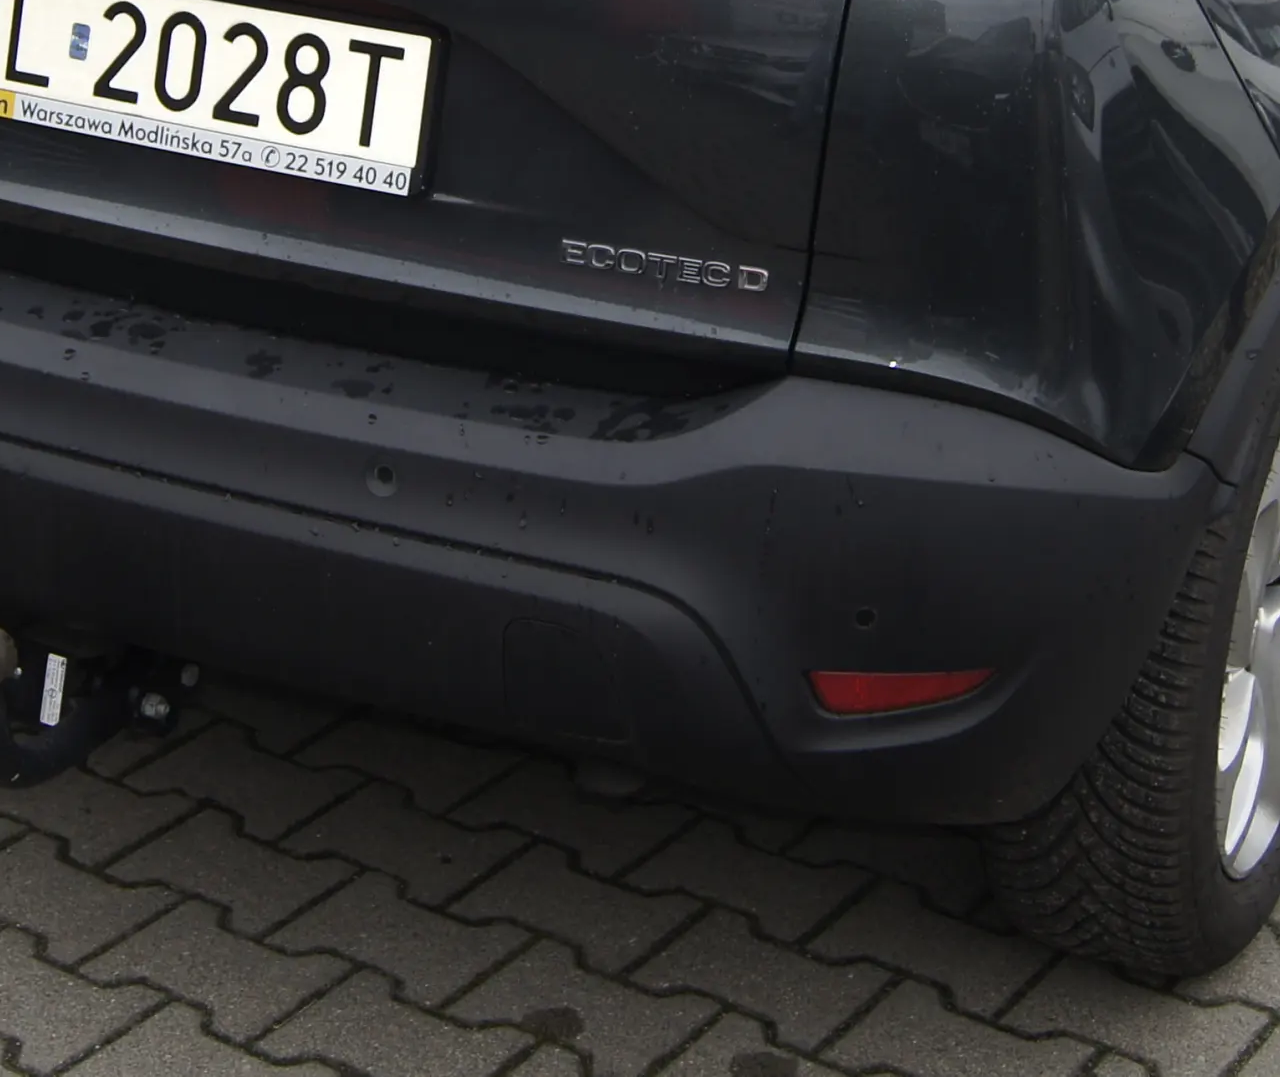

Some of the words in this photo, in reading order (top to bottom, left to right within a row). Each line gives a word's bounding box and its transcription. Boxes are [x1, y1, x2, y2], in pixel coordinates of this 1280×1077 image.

[93, 1, 405, 147] 2028T
[20, 100, 112, 134] Warszawa
[118, 120, 213, 155] Modlińska
[219, 139, 252, 163] 57a
[284, 153, 308, 173] 22
[314, 158, 348, 180] 519
[352, 166, 377, 185] 40
[382, 172, 407, 191] 40
[561, 238, 731, 288] ECOTEC
[737, 265, 769, 292] D
